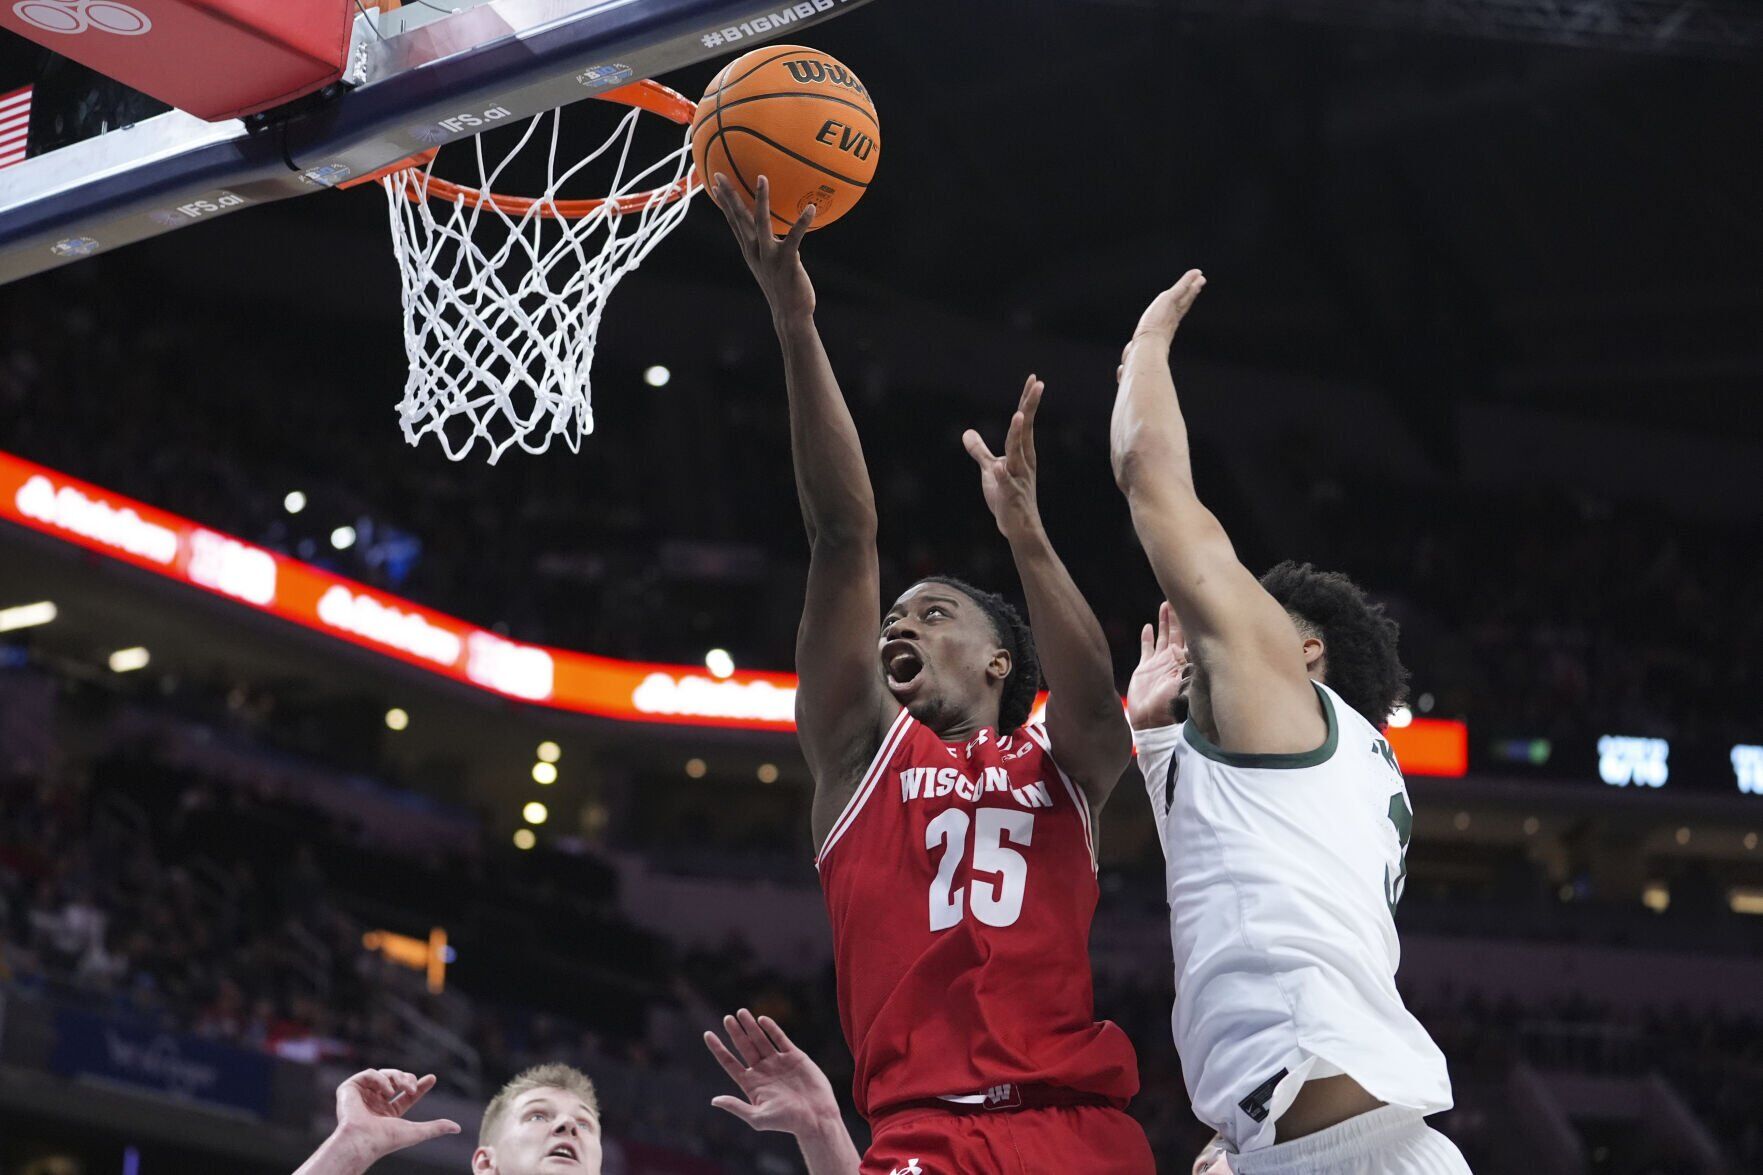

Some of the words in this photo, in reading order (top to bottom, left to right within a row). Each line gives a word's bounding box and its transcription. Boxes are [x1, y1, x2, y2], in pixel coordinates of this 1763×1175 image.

[701, 0, 848, 48] #B1GMBB
[815, 119, 874, 161] EVO
[900, 766, 1053, 808] WISCONIN
[925, 807, 1034, 932] 25
